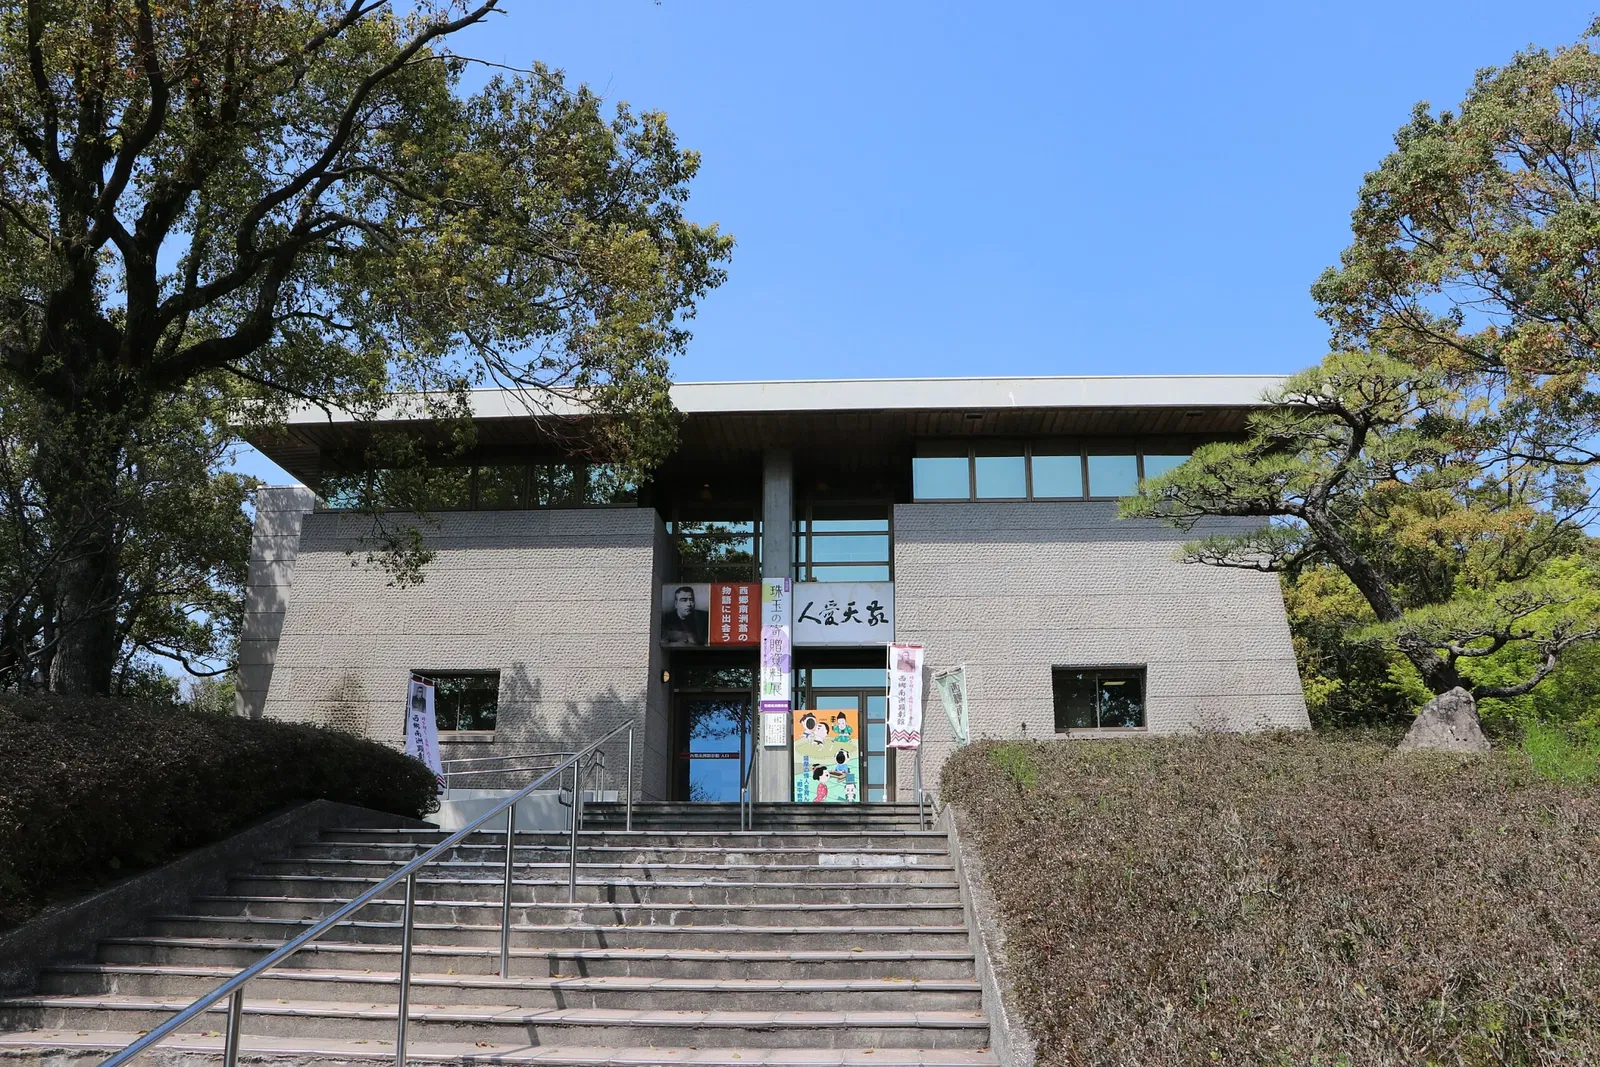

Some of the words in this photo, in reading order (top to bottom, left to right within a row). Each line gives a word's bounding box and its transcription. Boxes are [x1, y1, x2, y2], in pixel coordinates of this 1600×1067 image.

[721, 586, 732, 642] 物語に出会う
[738, 586, 749, 642] 西郷南洲翁の
[770, 585, 783, 696] 珠玉の寄贈資料展
